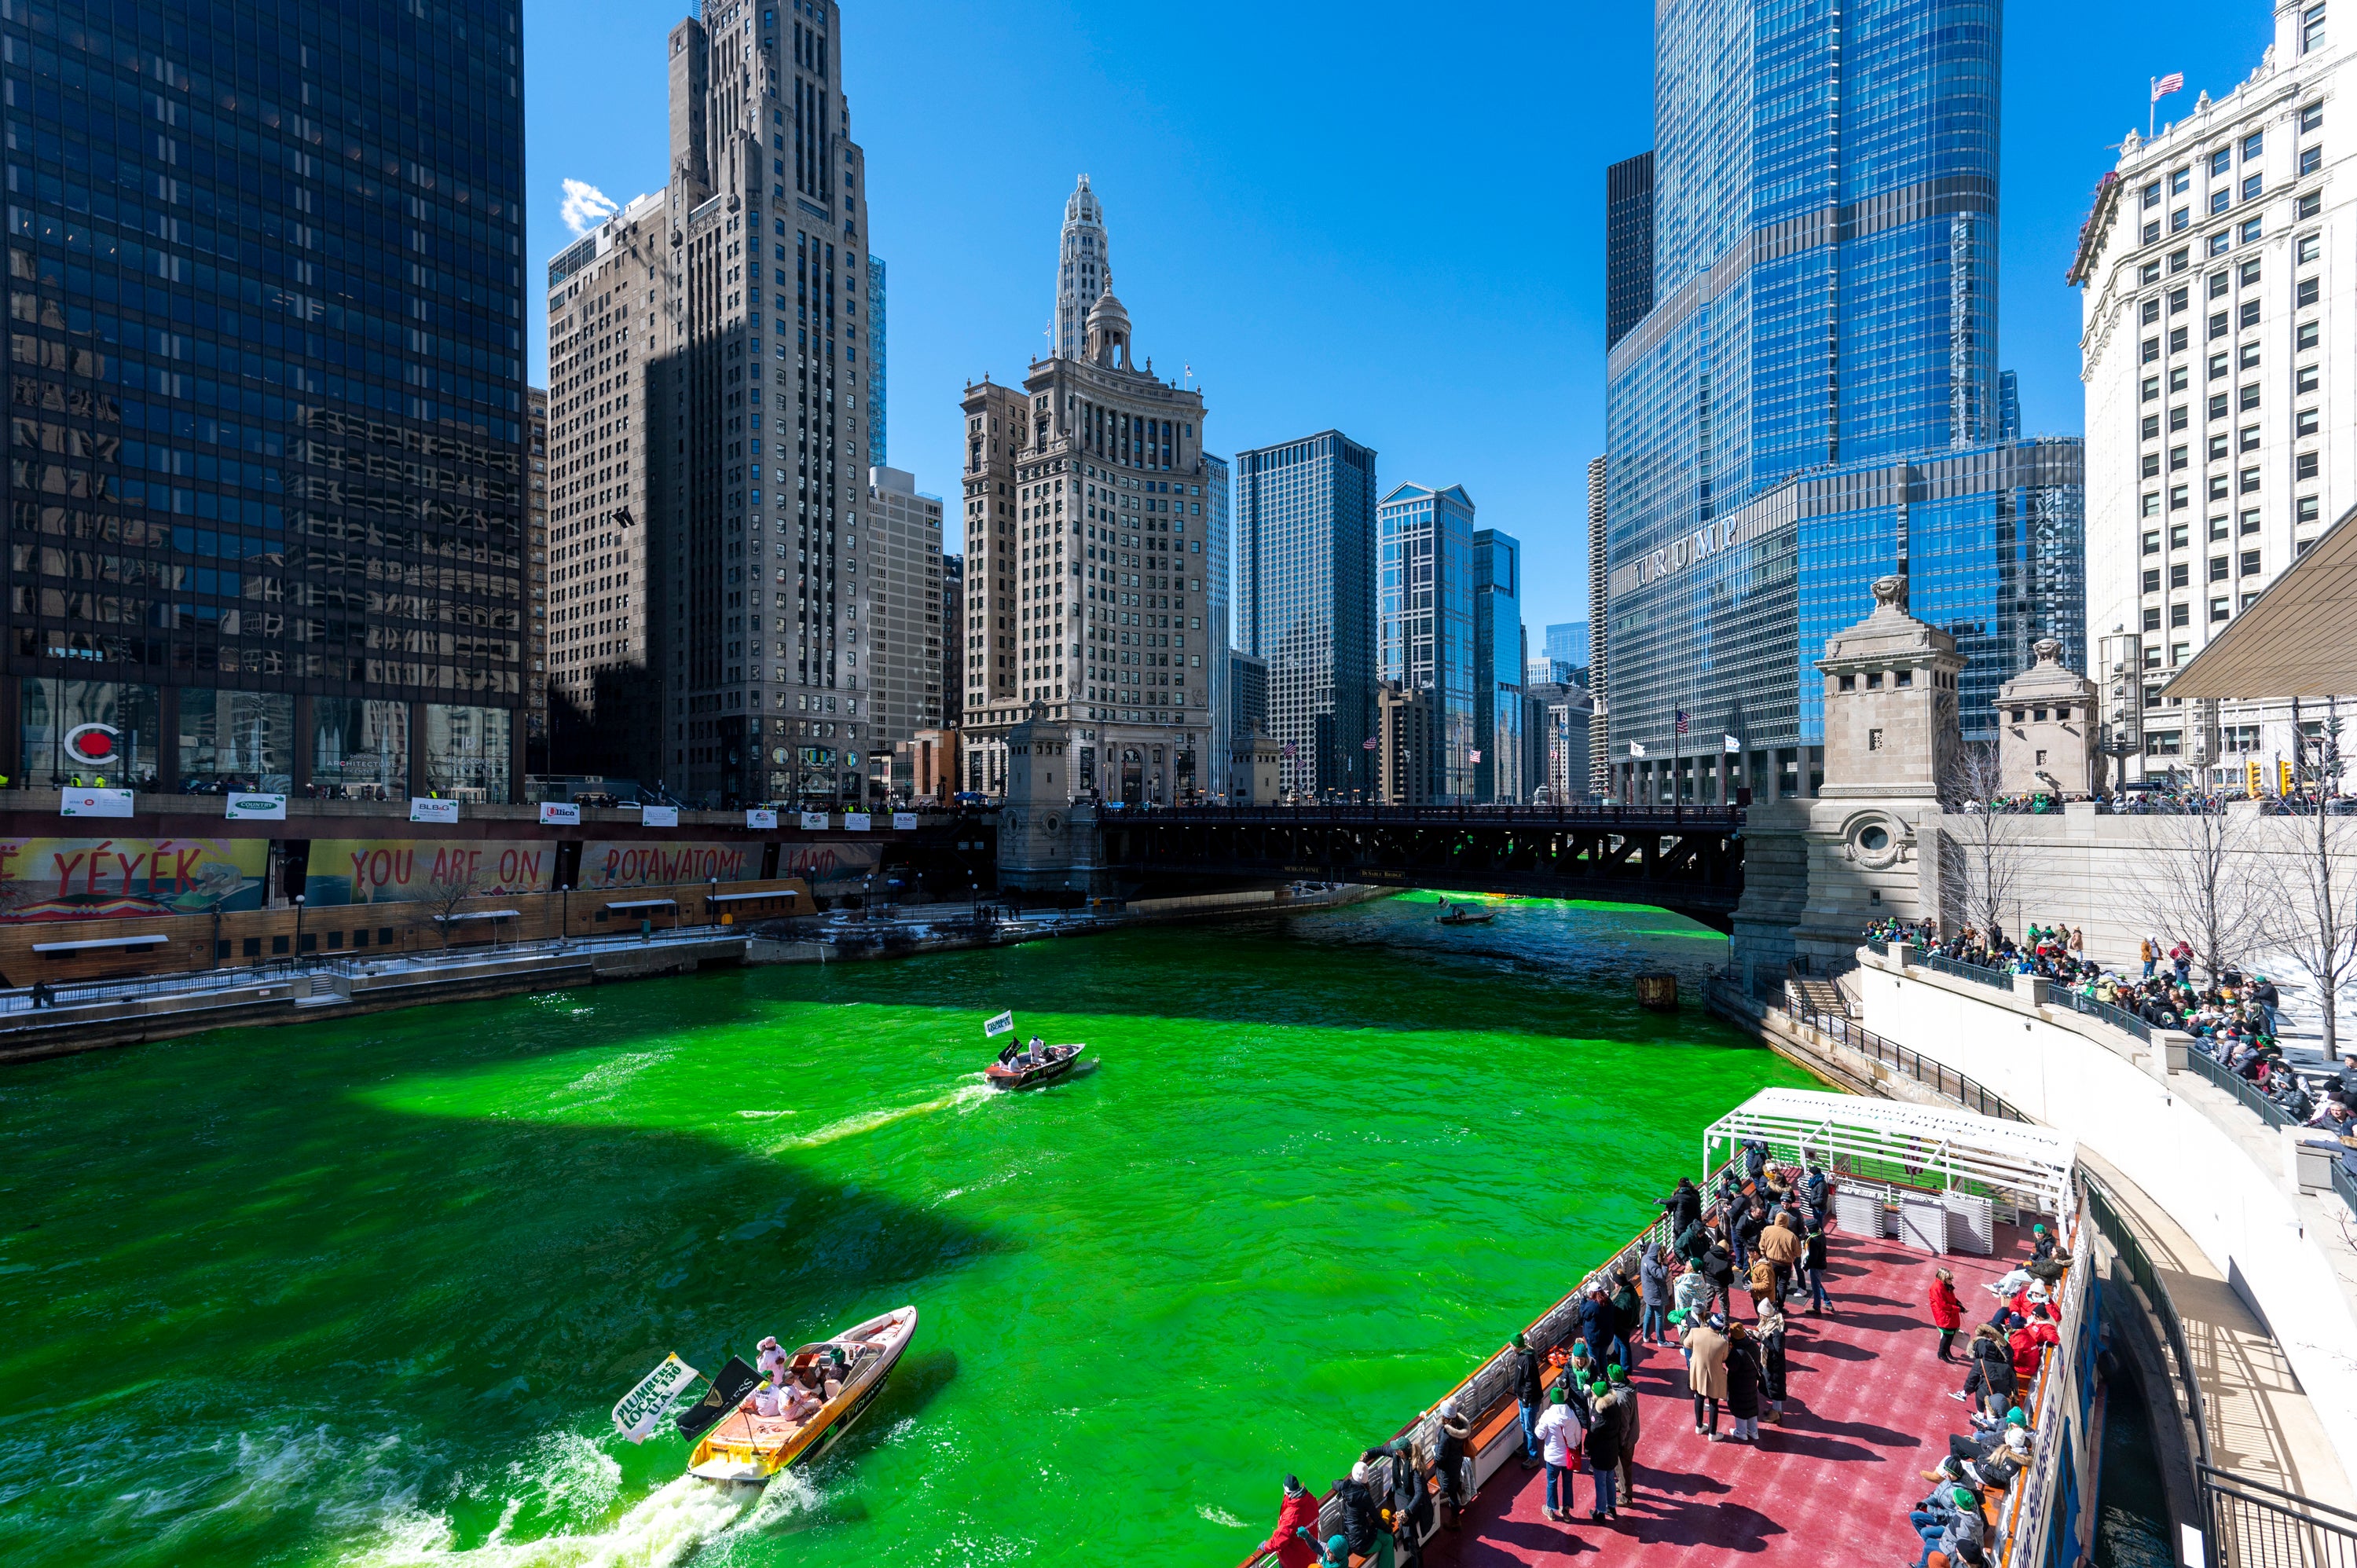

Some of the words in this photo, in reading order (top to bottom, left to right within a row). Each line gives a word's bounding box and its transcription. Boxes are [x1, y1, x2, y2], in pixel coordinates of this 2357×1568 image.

[1635, 515, 1737, 588] TRUMP
[546, 807, 575, 817] Ullico
[53, 841, 201, 897] YÉYÉK
[350, 848, 414, 888] YOU
[430, 847, 482, 886] ARE
[499, 848, 541, 884] ON
[605, 848, 742, 882] POTAWATOMI
[788, 848, 836, 878] LAND
[988, 1021, 1005, 1032] LOCAL
[617, 1361, 675, 1421] PLUMBERS
[623, 1390, 663, 1431] LOCAL
[660, 1365, 682, 1387] 130
[647, 1391, 674, 1416] U.A.
[2029, 1393, 2057, 1535] Sightseeing
